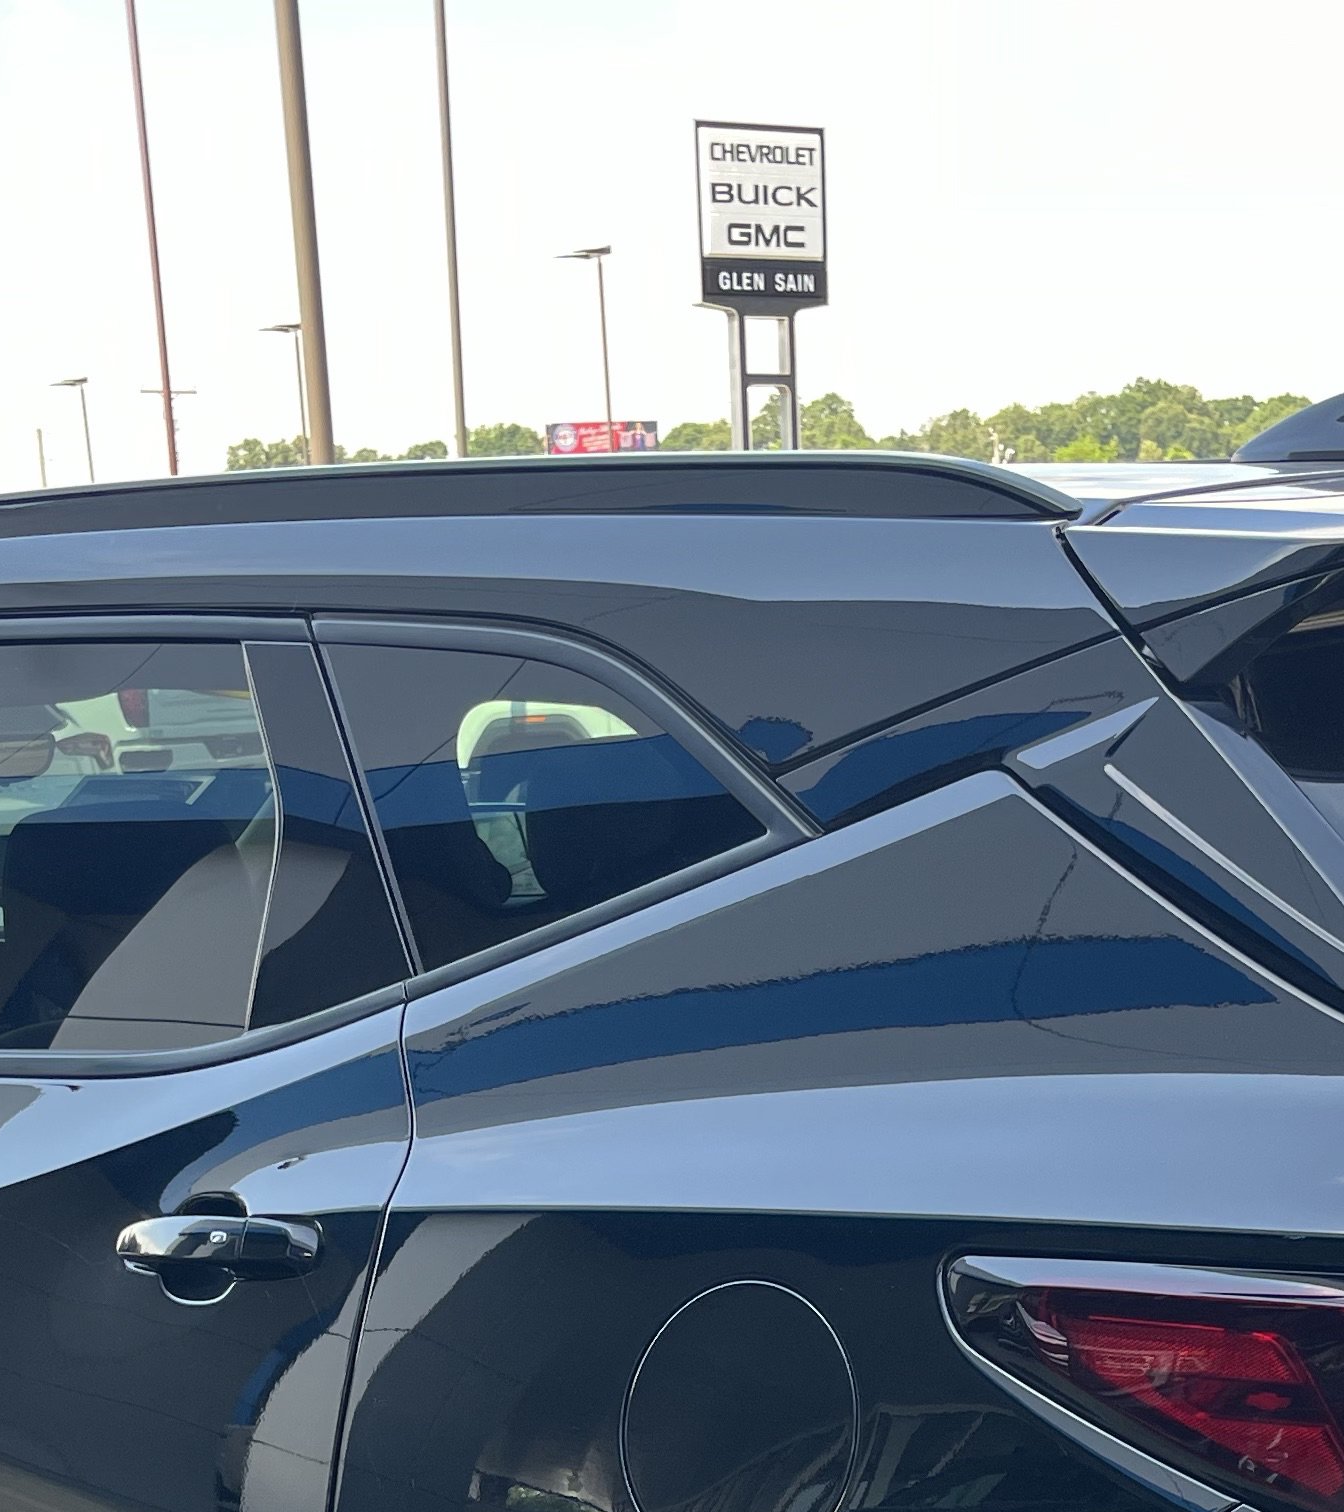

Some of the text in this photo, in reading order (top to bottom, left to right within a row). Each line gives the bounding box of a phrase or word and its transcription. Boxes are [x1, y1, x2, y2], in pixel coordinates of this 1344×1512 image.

[710, 142, 816, 166] CHEVROLET
[710, 182, 819, 208] BUICK
[727, 223, 806, 248] GMC
[718, 271, 816, 293] GLEN SAIN
